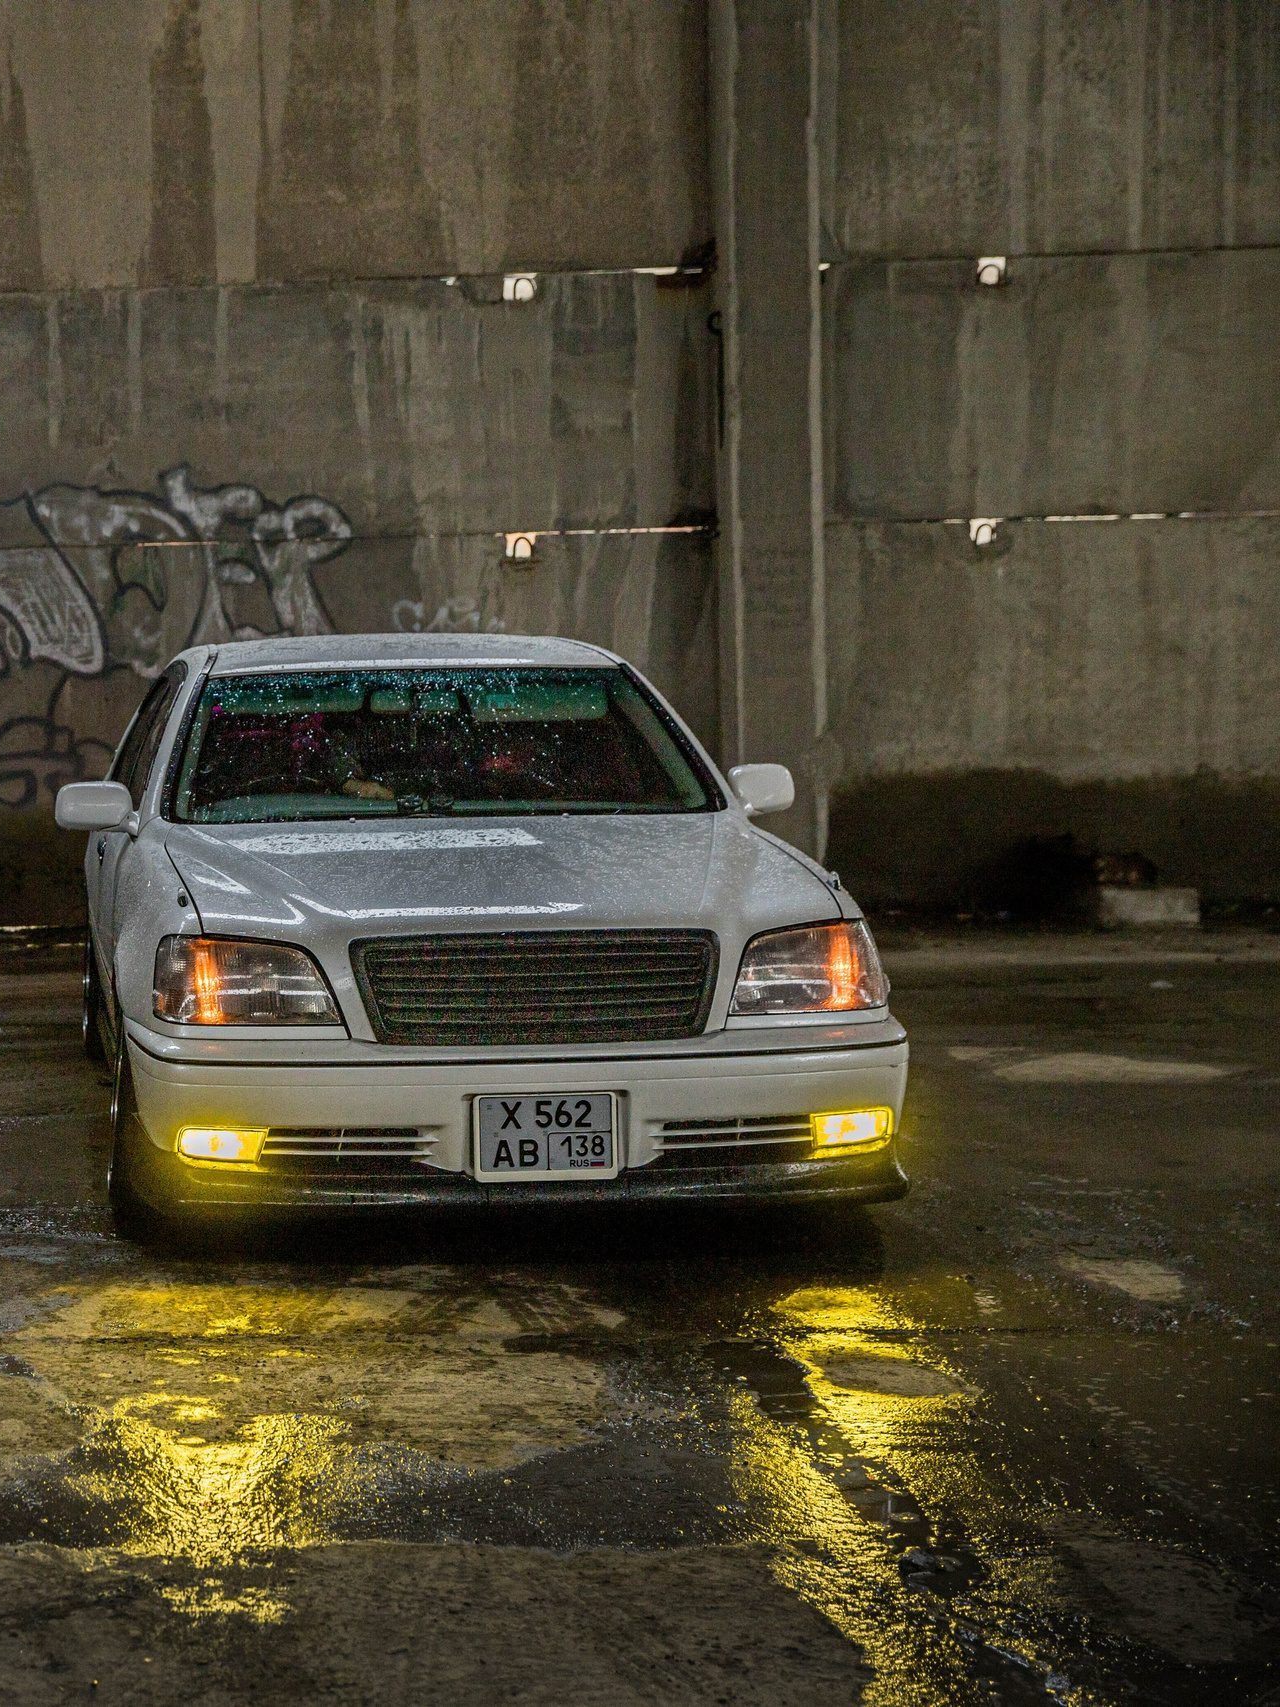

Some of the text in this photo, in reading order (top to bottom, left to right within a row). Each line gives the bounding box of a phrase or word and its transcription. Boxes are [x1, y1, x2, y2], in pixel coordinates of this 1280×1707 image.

[500, 1099, 592, 1130] X 562
[493, 1139, 539, 1168] AB
[560, 1135, 605, 1158] 138
[569, 1158, 590, 1168] RUS
